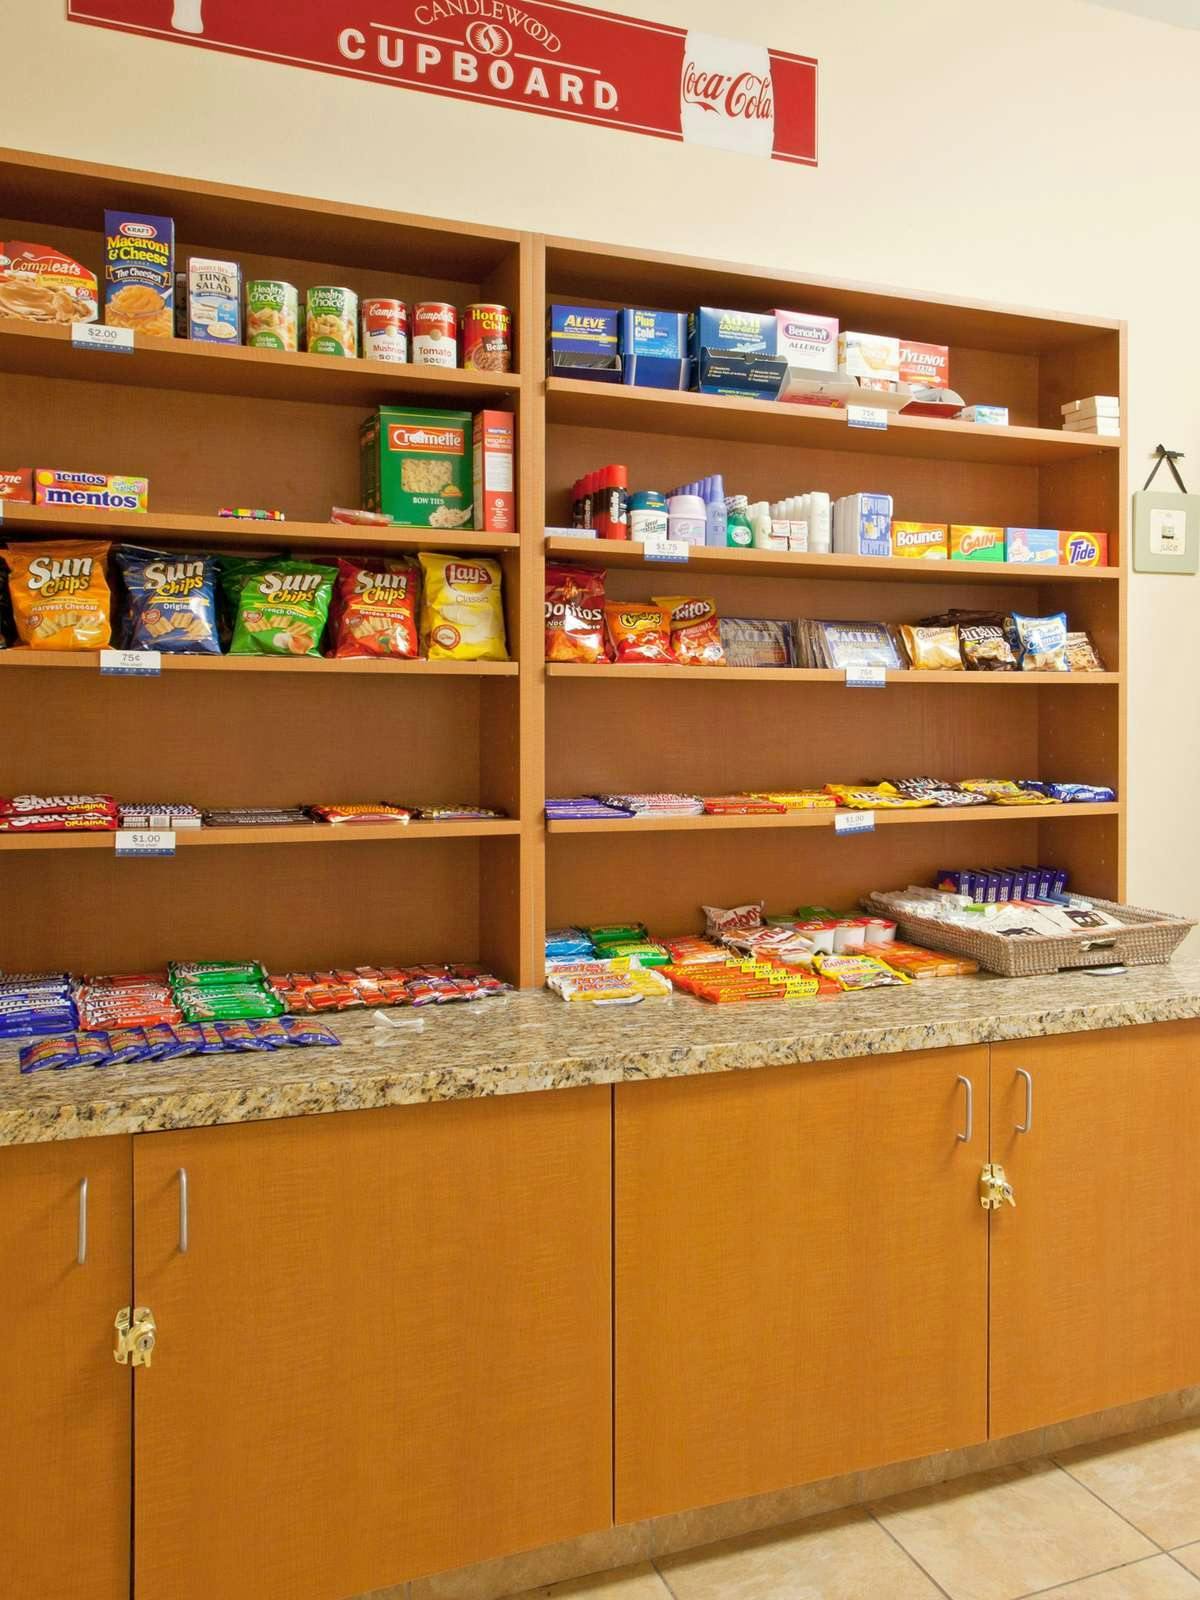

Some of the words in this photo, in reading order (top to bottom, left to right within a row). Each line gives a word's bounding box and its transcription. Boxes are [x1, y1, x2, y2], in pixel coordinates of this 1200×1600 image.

[414, 0, 562, 53] CANDLEWOOD
[336, 28, 618, 110] CUPBOARD
[107, 235, 169, 257] Macaroni
[10, 257, 81, 275] Compleats
[108, 249, 119, 261] &
[119, 247, 168, 266] Cheese
[195, 282, 232, 294] SALAD
[199, 273, 228, 285] TUNA
[564, 313, 608, 329] ALEVE
[88, 327, 117, 339] $2.00
[634, 327, 656, 340] Cold
[418, 346, 453, 357] Tomato
[788, 342, 827, 353] ALLERGY
[899, 349, 946, 368] TYLENOL
[47, 490, 139, 509] mentos
[896, 529, 944, 548] Bounce
[1069, 540, 1097, 566] Tide
[27, 557, 93, 591] Sun
[144, 560, 205, 590] Sun
[259, 571, 323, 595] Sun
[354, 569, 408, 595] Sun
[448, 564, 489, 586] Lay's
[40, 576, 90, 597] Chips
[157, 576, 204, 596] Chips
[267, 589, 315, 604] Chips
[361, 588, 407, 605] Chips
[132, 834, 161, 843] $1.00
